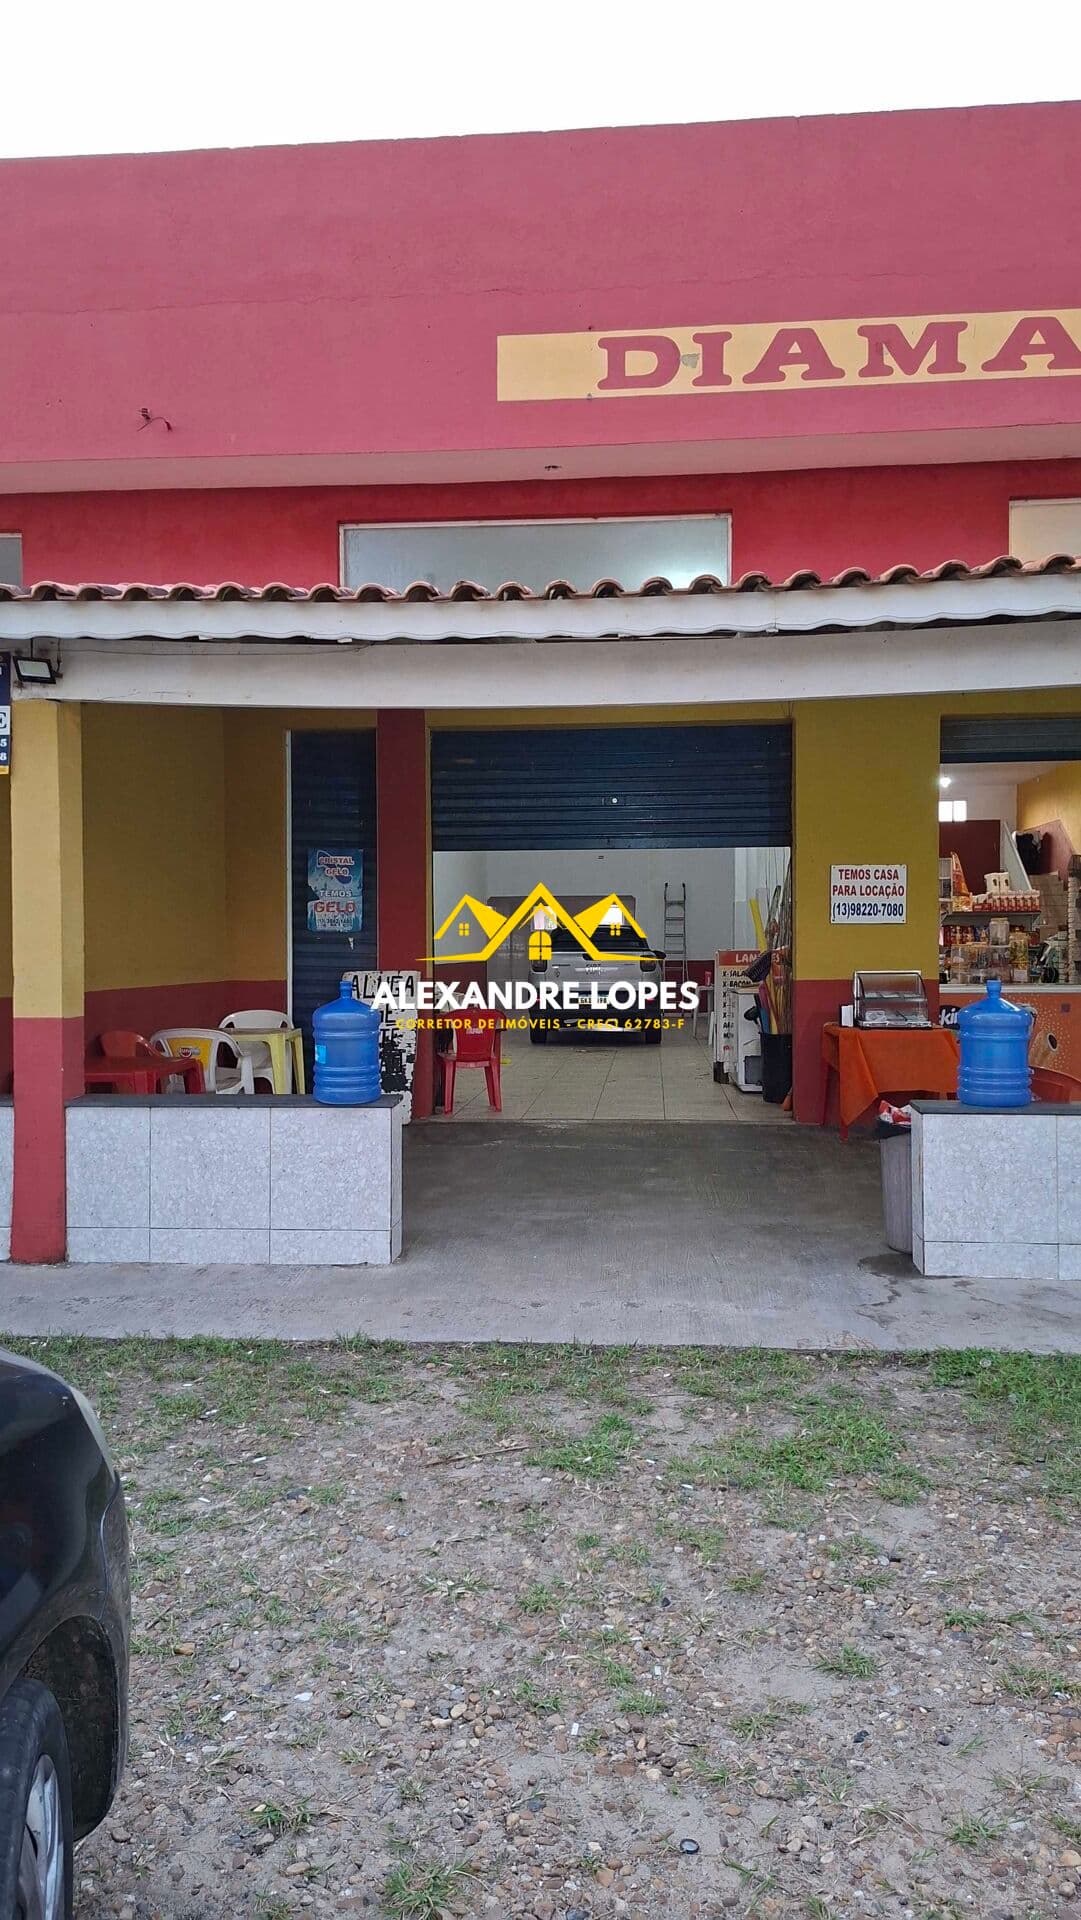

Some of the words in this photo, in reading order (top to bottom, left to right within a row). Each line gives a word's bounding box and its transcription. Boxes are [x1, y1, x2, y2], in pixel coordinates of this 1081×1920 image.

[598, 316, 1081, 390] DIAMA
[325, 867, 350, 876] GELO
[838, 868, 871, 881] TEMOS
[873, 868, 899, 881] CASA
[319, 889, 353, 898] TEMOS
[832, 884, 857, 897] PARA
[859, 882, 905, 900] LOCAÇÃO
[313, 900, 356, 913] GELO
[832, 902, 904, 920] (13)98220-7080
